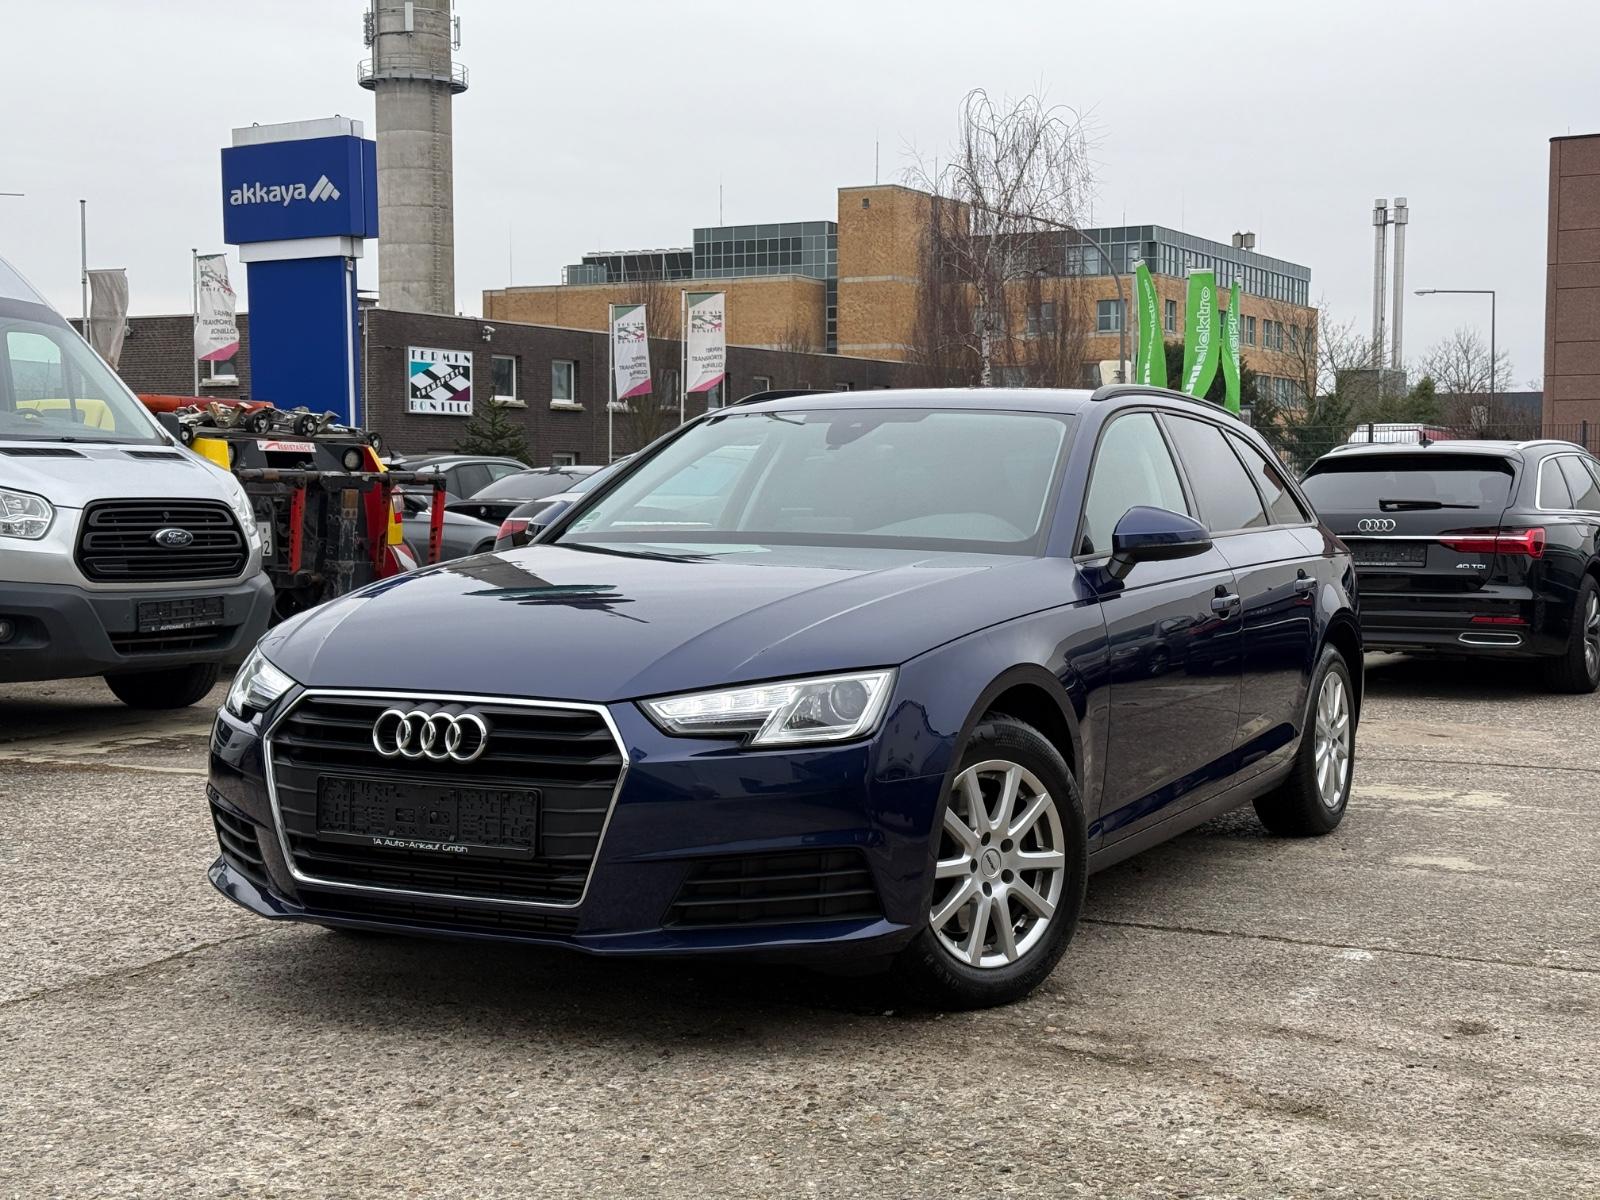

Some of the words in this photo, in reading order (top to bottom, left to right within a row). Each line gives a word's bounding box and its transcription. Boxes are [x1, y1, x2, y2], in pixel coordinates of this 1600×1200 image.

[230, 182, 306, 207] akkaya
[411, 350, 470, 363] TERMIN
[416, 366, 464, 398] TRANSPORTE
[410, 401, 470, 413] BONILLO
[166, 531, 188, 543] Ford
[384, 840, 440, 850] Auto-Ankauf
